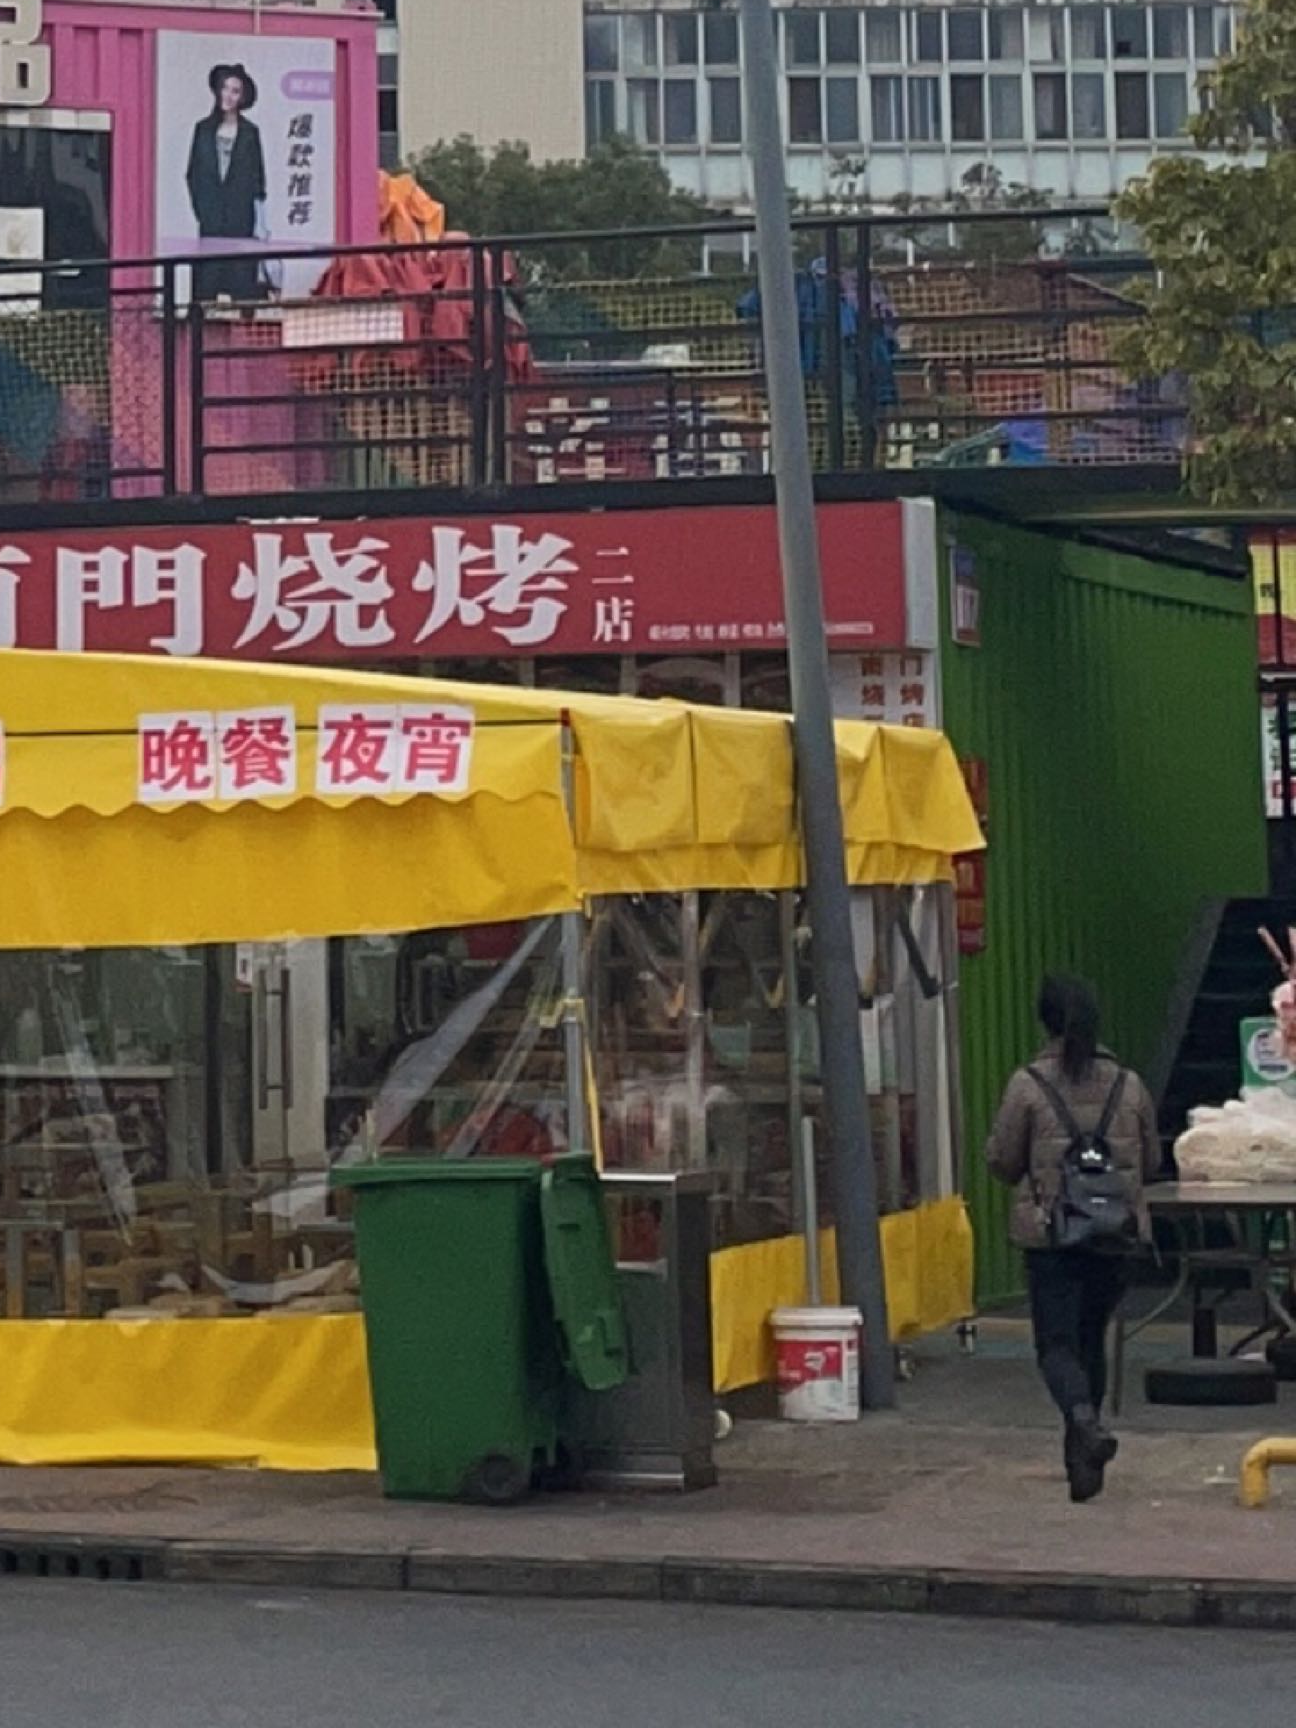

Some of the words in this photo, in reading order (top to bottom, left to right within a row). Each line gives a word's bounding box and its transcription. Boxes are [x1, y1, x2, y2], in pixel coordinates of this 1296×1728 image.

[592, 547, 634, 642] 二店
[142, 717, 291, 792] 晚餐
[321, 712, 472, 784] 夜宵
